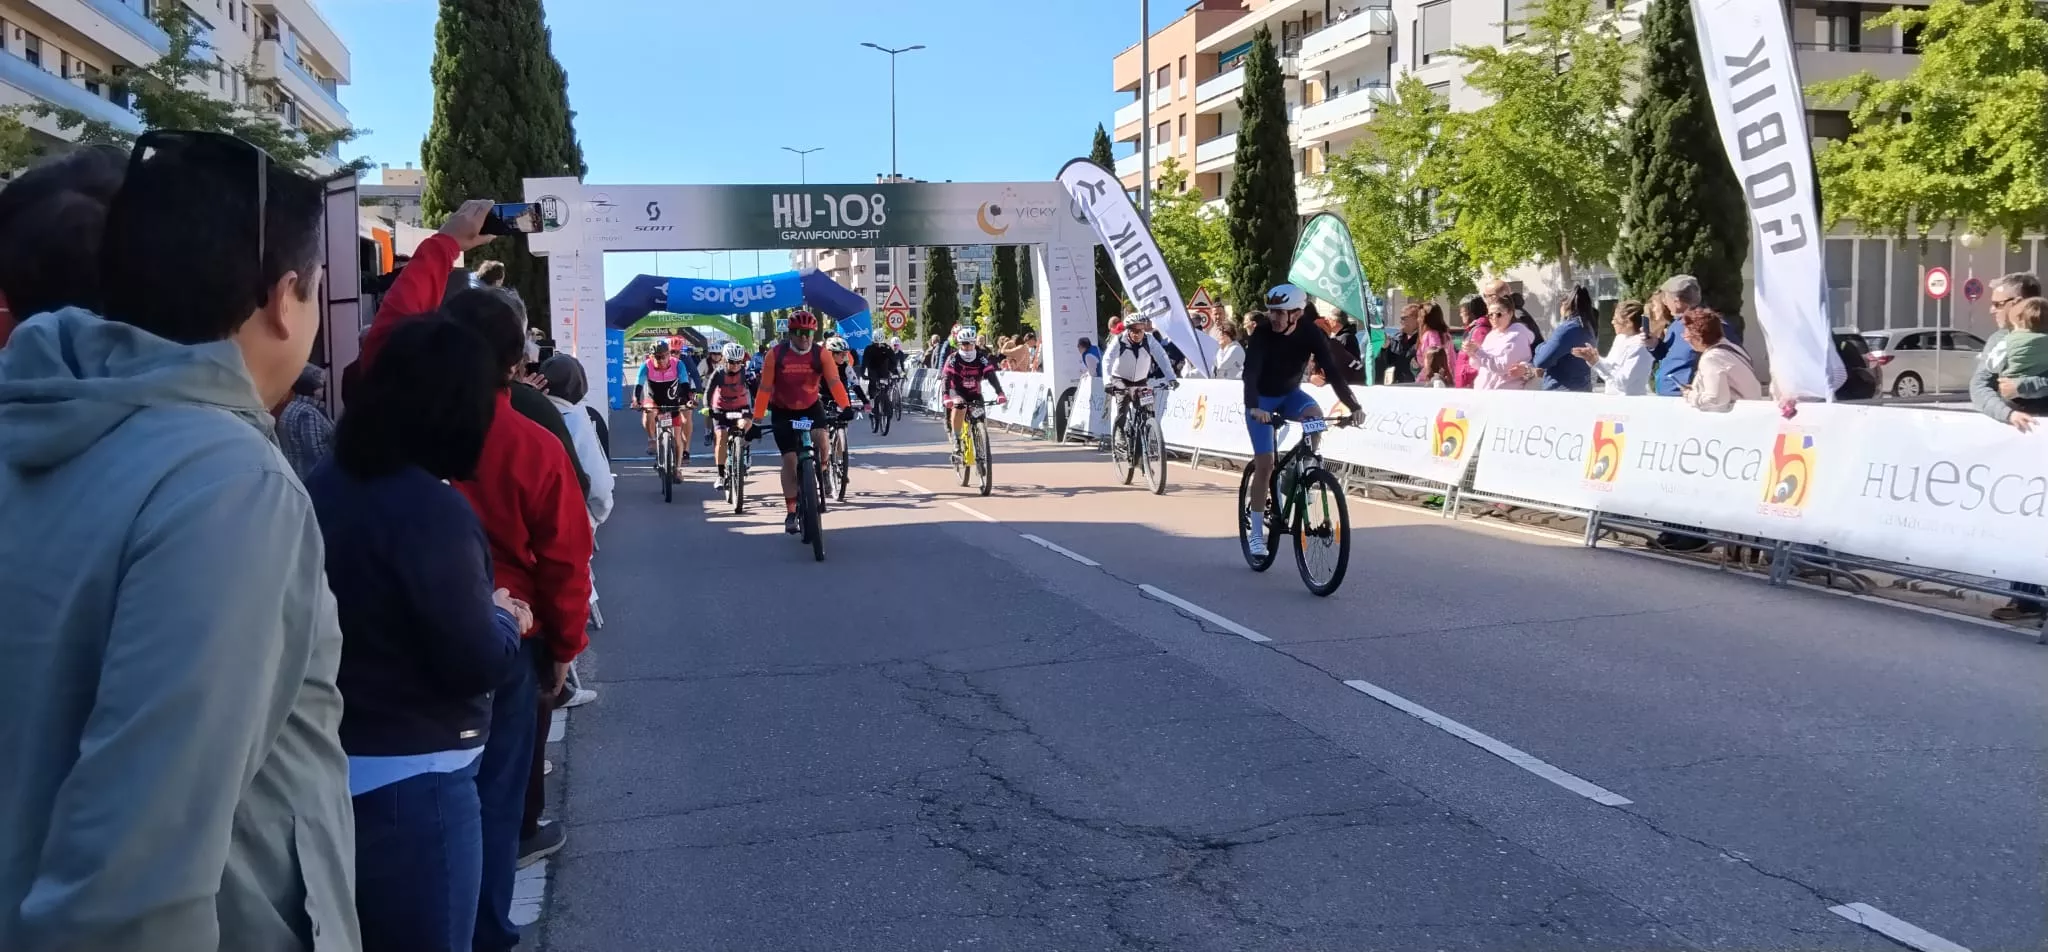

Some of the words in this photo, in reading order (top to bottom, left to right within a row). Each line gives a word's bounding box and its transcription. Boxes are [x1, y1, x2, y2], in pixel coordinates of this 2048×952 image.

[1725, 36, 1808, 255] GOBIK
[772, 193, 886, 229] HU-108
[1108, 221, 1172, 320] GOBIK
[1492, 424, 1584, 462] Huesca
[1637, 437, 1762, 481] Huesca
[1860, 460, 2047, 517] Huesca
